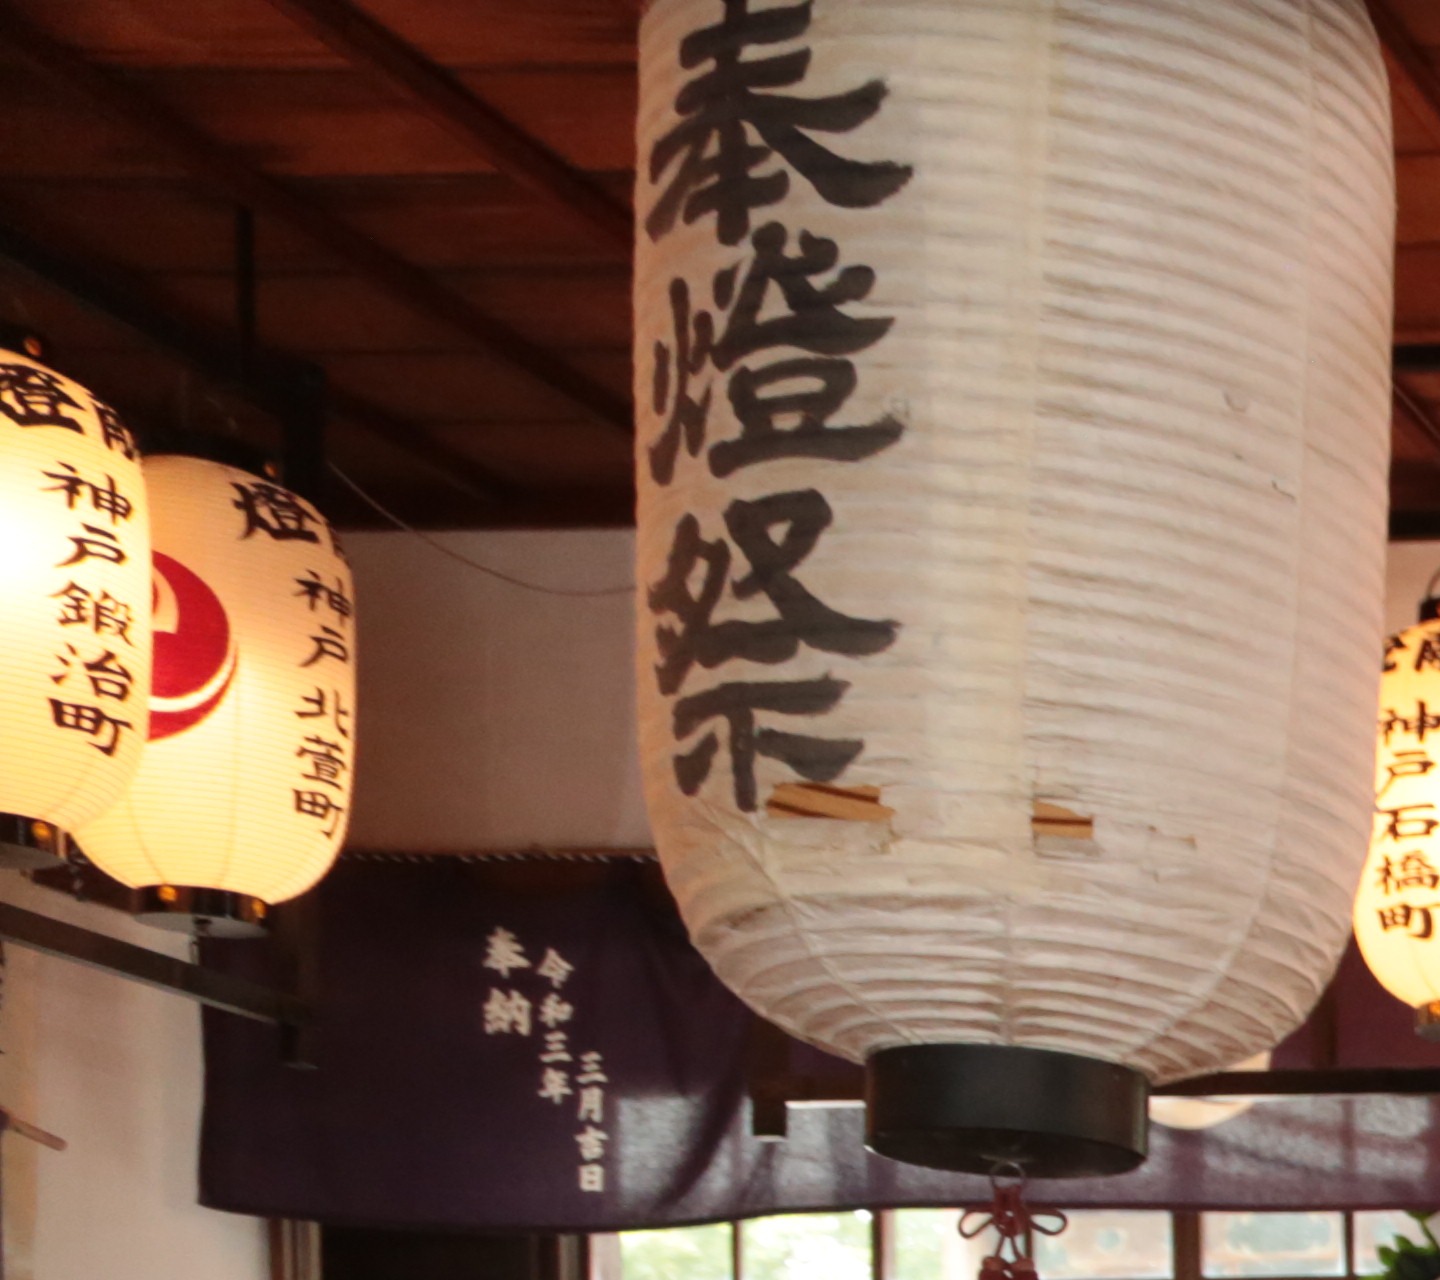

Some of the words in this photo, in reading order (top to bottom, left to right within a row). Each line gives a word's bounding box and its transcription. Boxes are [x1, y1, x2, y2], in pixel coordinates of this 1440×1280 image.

[482, 926, 532, 1037] 奉納
[574, 1051, 609, 1192] 三月吉日
